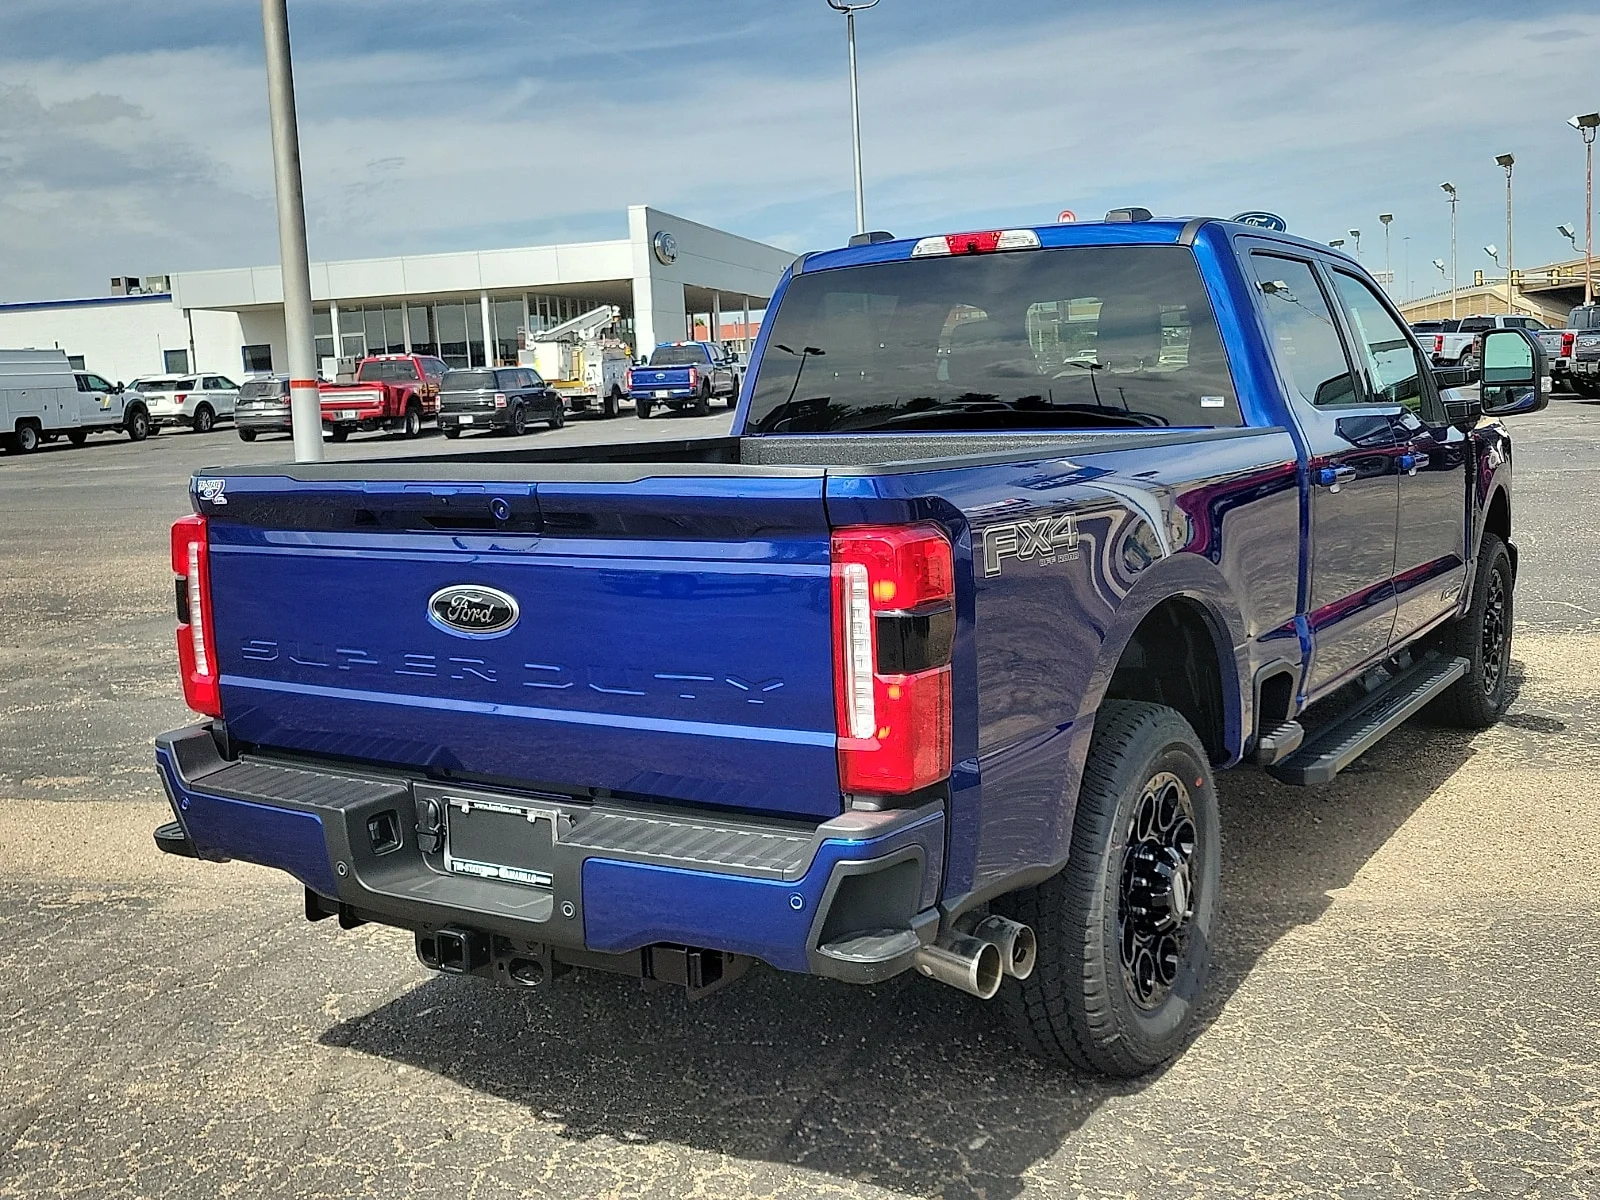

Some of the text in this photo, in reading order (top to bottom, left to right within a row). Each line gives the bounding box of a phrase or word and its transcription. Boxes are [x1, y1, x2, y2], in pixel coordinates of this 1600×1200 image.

[983, 512, 1080, 578] FX4
[447, 595, 495, 623] Ford
[241, 639, 785, 704] SUPER DUTY
